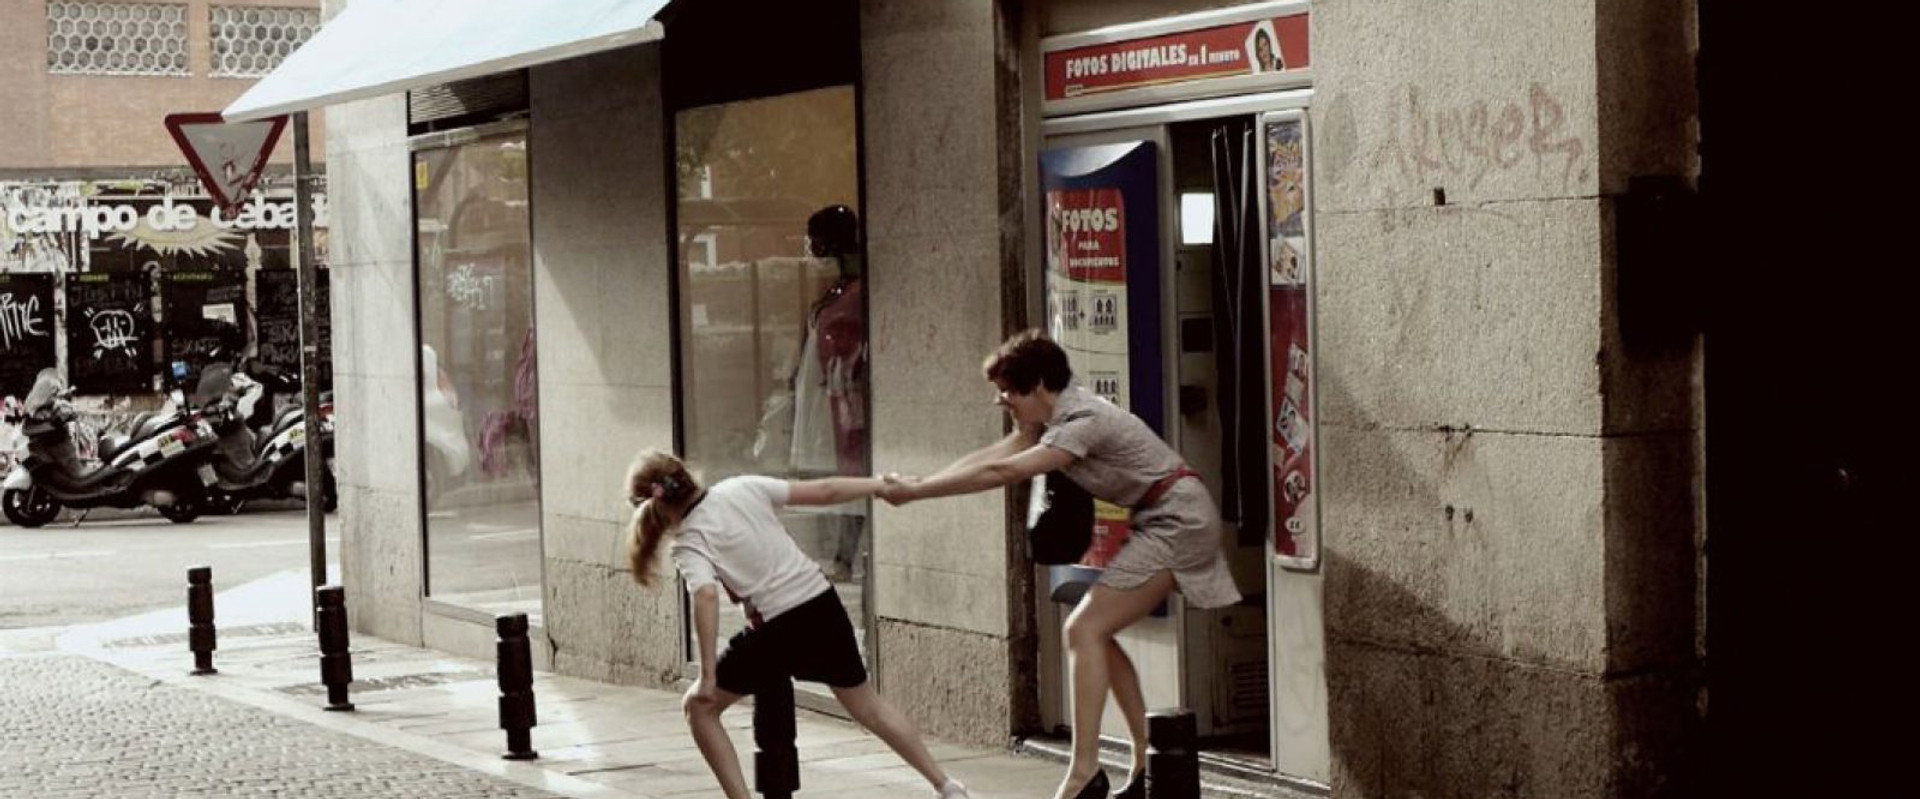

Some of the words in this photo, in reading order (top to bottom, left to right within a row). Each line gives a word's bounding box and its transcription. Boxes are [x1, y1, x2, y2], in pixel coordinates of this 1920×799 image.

[1066, 55, 1108, 79] FOTOS
[1111, 44, 1187, 73] DIGITALES
[8, 203, 138, 239] campo
[147, 193, 198, 231] de
[1062, 208, 1119, 232] FOTOS
